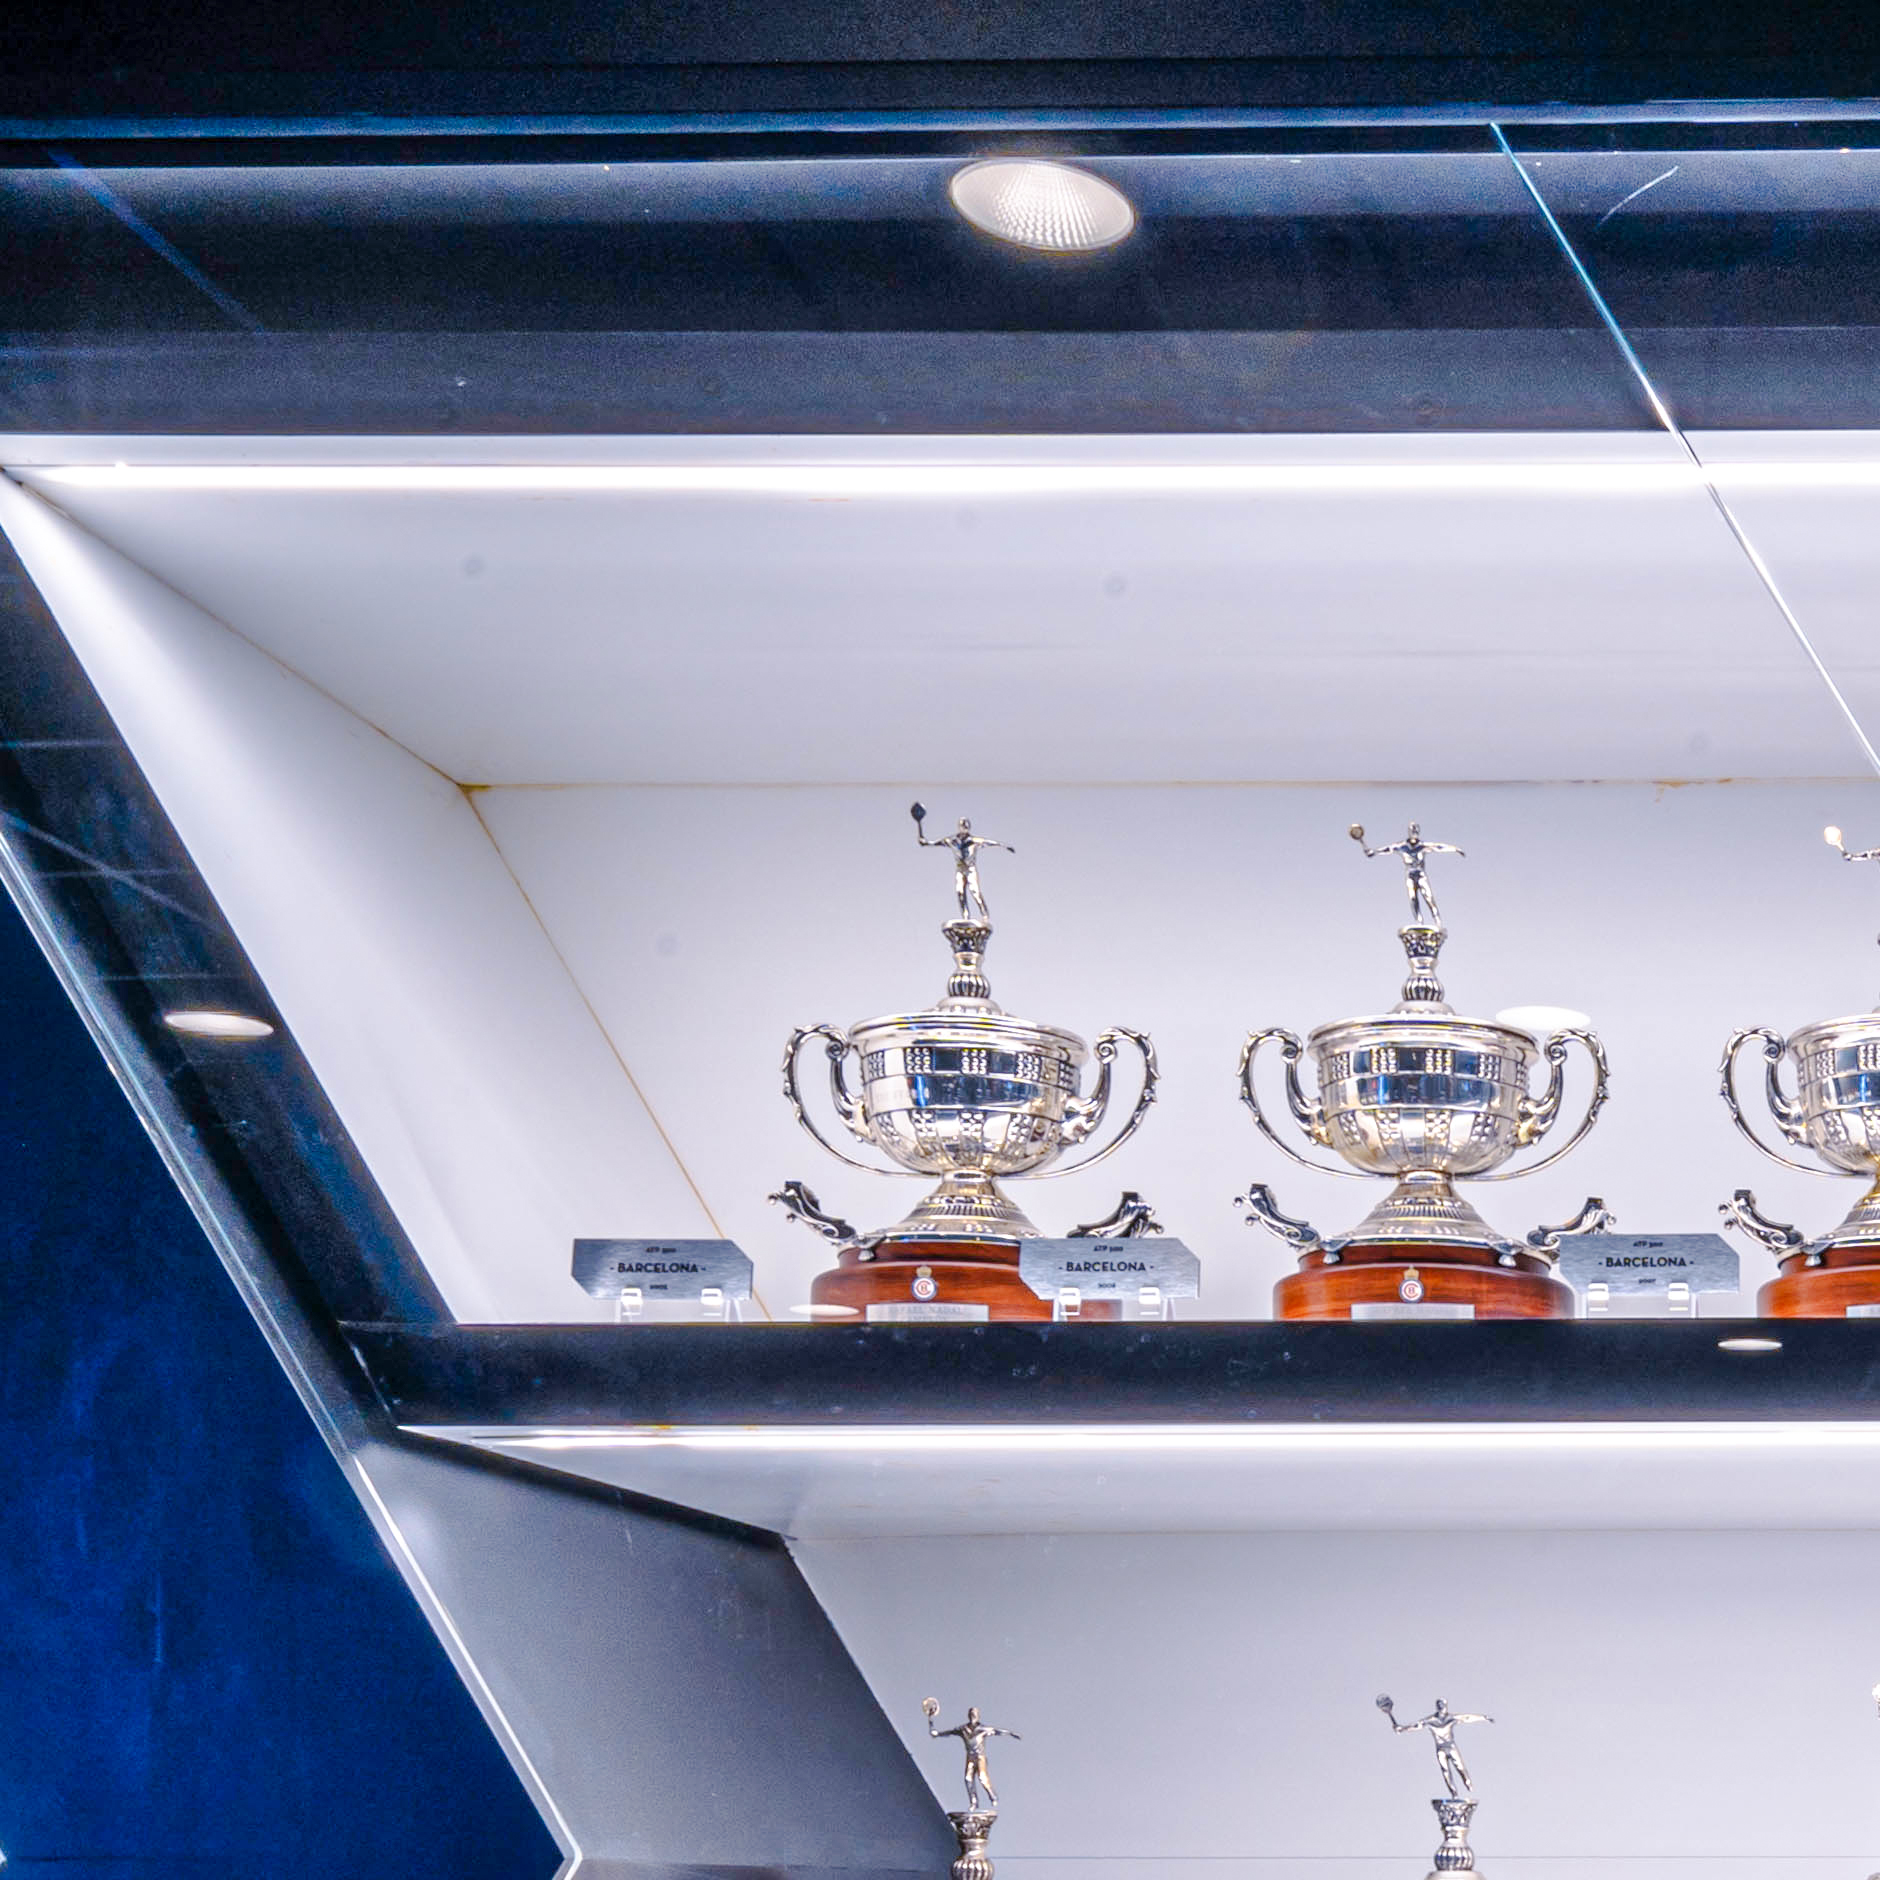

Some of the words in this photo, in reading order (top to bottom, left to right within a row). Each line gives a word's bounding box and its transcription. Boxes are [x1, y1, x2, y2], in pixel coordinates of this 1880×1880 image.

[1066, 1262, 1146, 1272] BARCELONA
[1606, 1257, 1687, 1267] BARCELONA
[618, 1263, 698, 1273] BARCELONA
